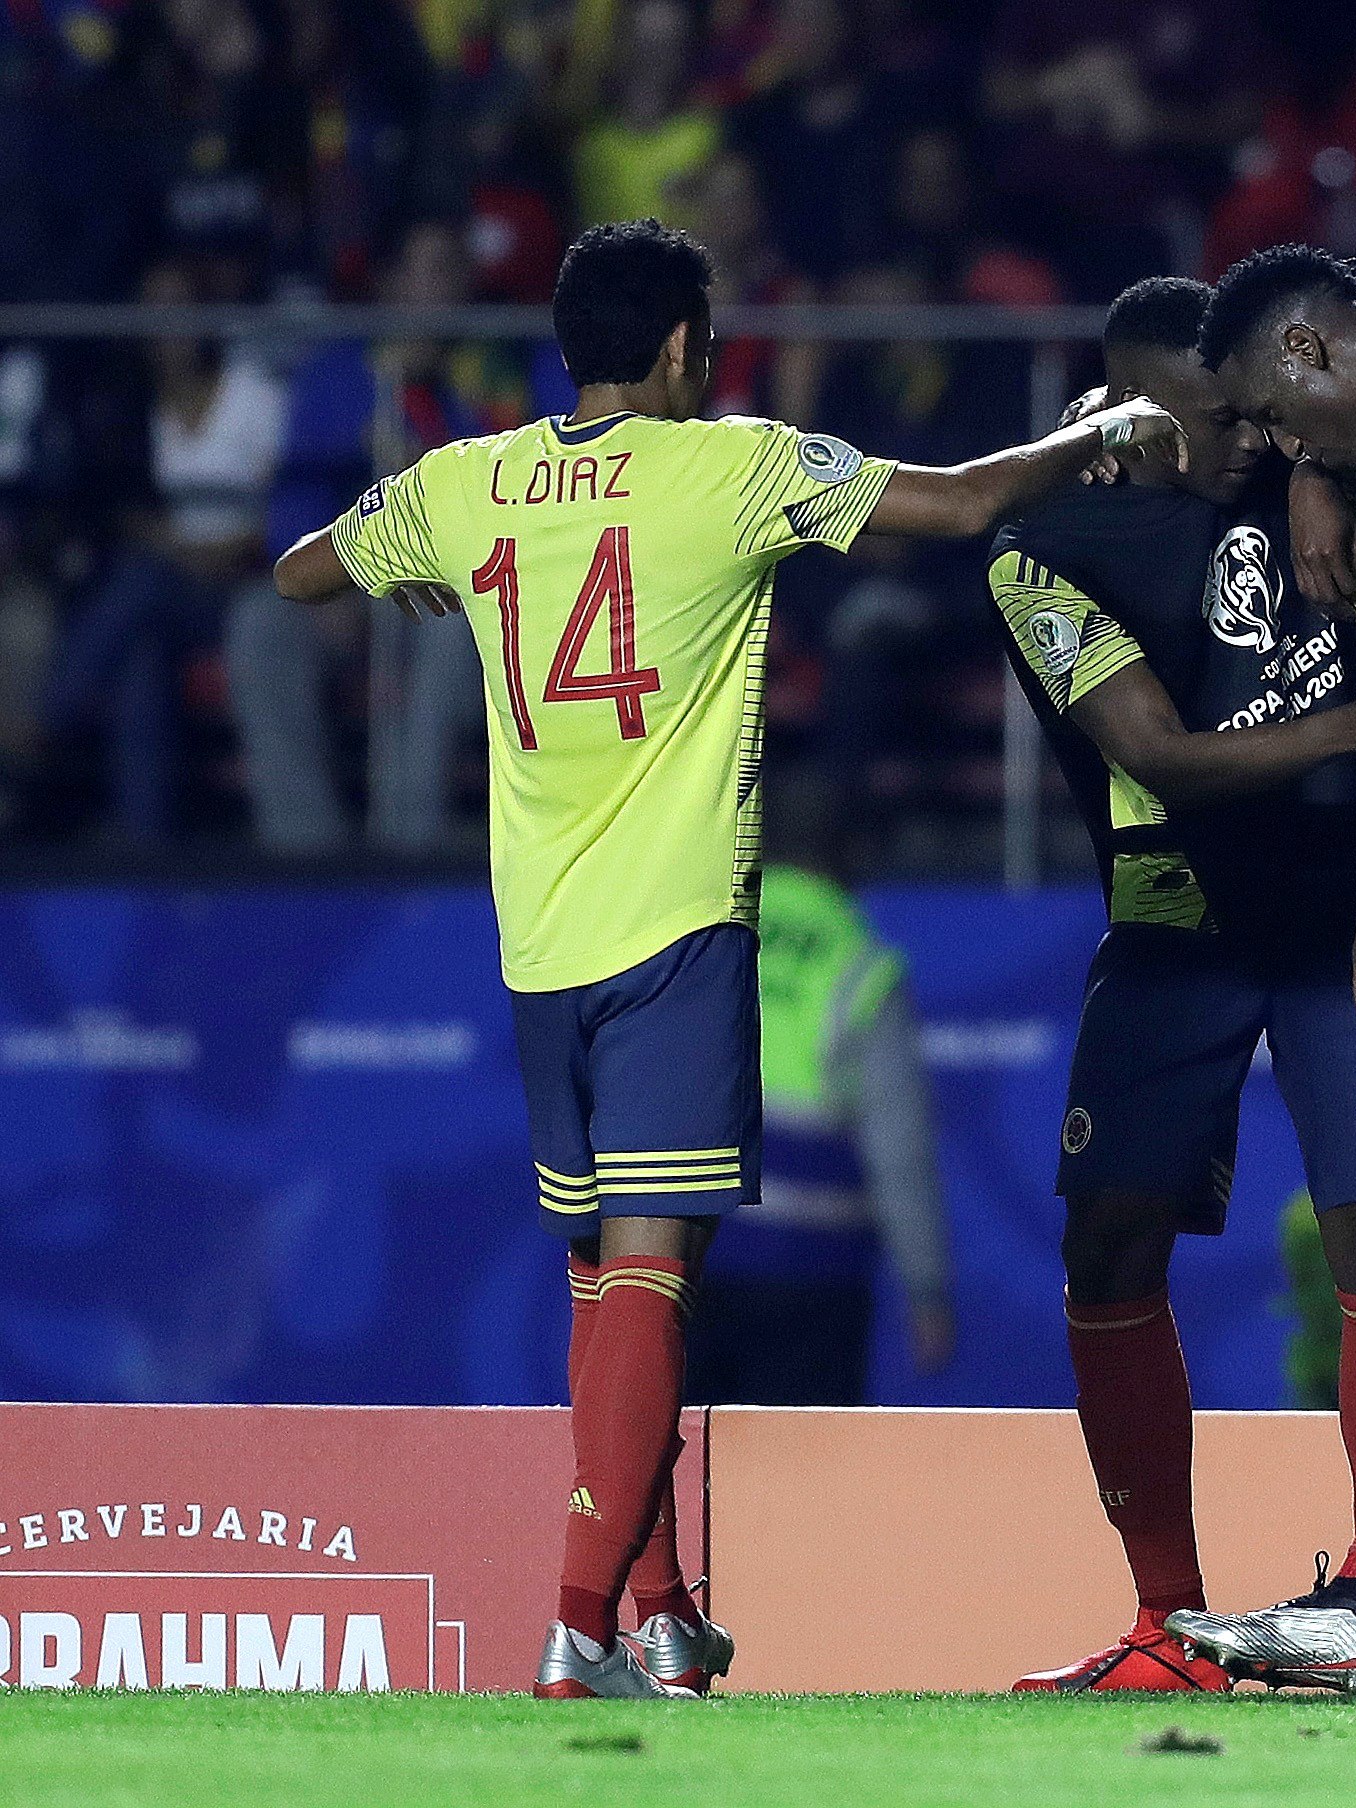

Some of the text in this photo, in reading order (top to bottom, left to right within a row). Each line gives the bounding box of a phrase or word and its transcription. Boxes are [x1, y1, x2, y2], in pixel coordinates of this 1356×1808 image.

[490, 452, 634, 505] L.DIAZ
[472, 526, 660, 751] 14
[0, 1611, 392, 1694] RAHMA
